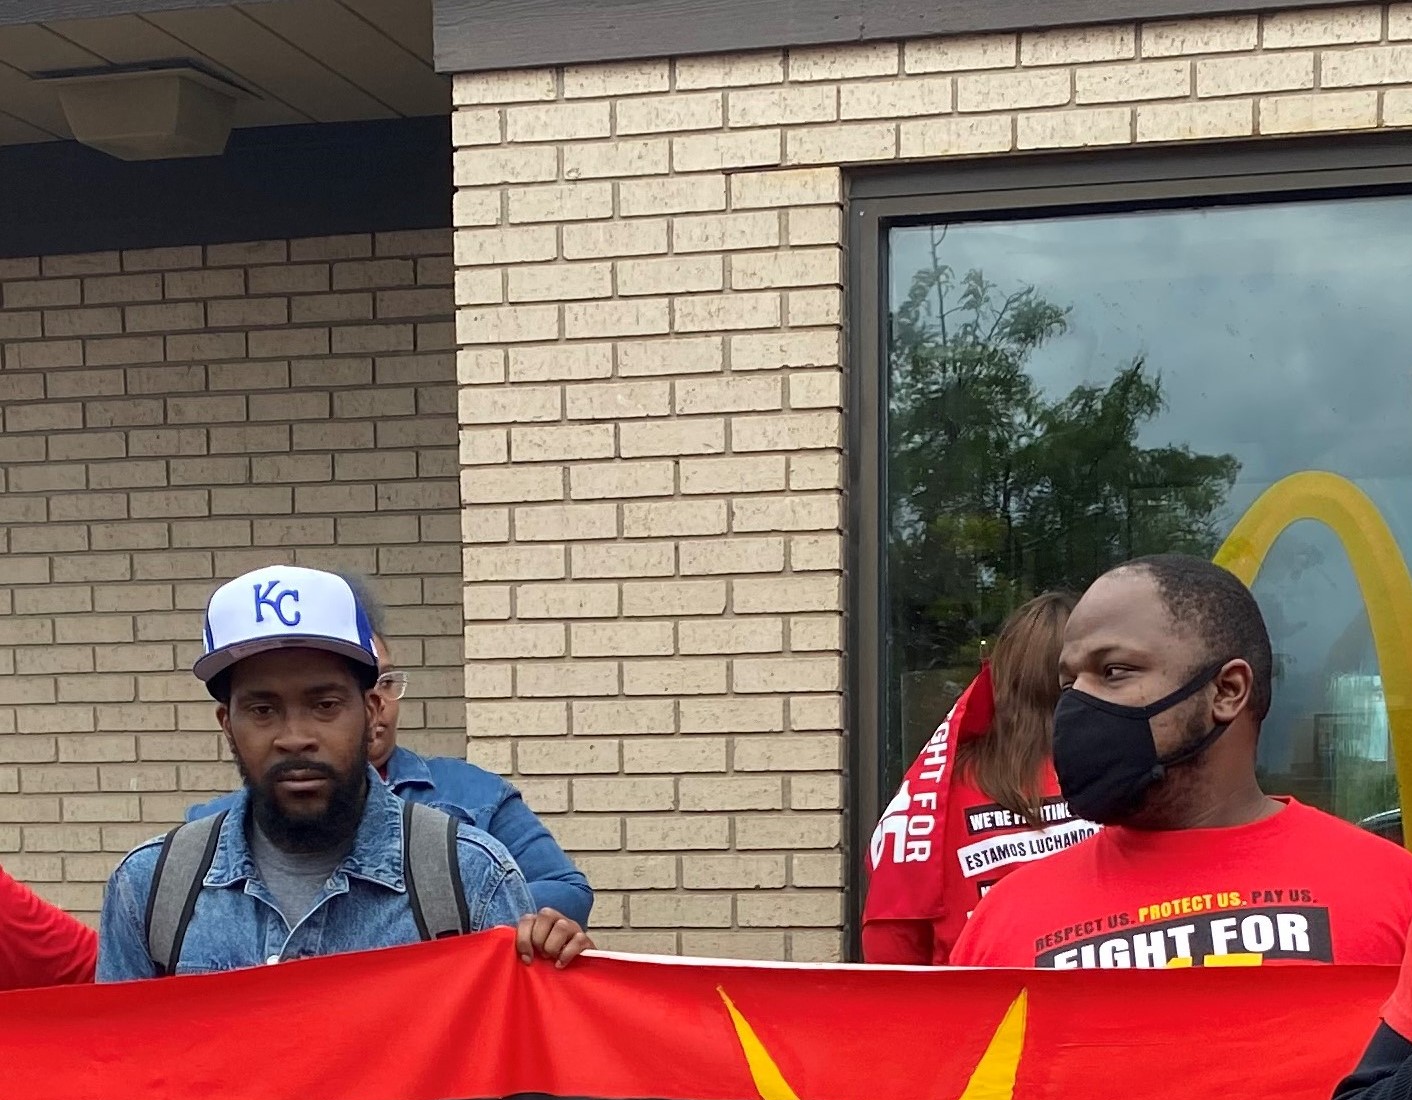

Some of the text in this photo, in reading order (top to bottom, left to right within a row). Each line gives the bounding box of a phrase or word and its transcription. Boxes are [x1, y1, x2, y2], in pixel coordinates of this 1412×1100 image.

[253, 580, 300, 626] KC
[905, 792, 937, 863] FOR
[969, 809, 1012, 831] WE'RE
[964, 841, 1027, 871] ESTAMOS
[1035, 889, 1318, 952] RESPECT US. PROTECT US. PAY US.
[1053, 913, 1310, 969] FIGHT FOR
